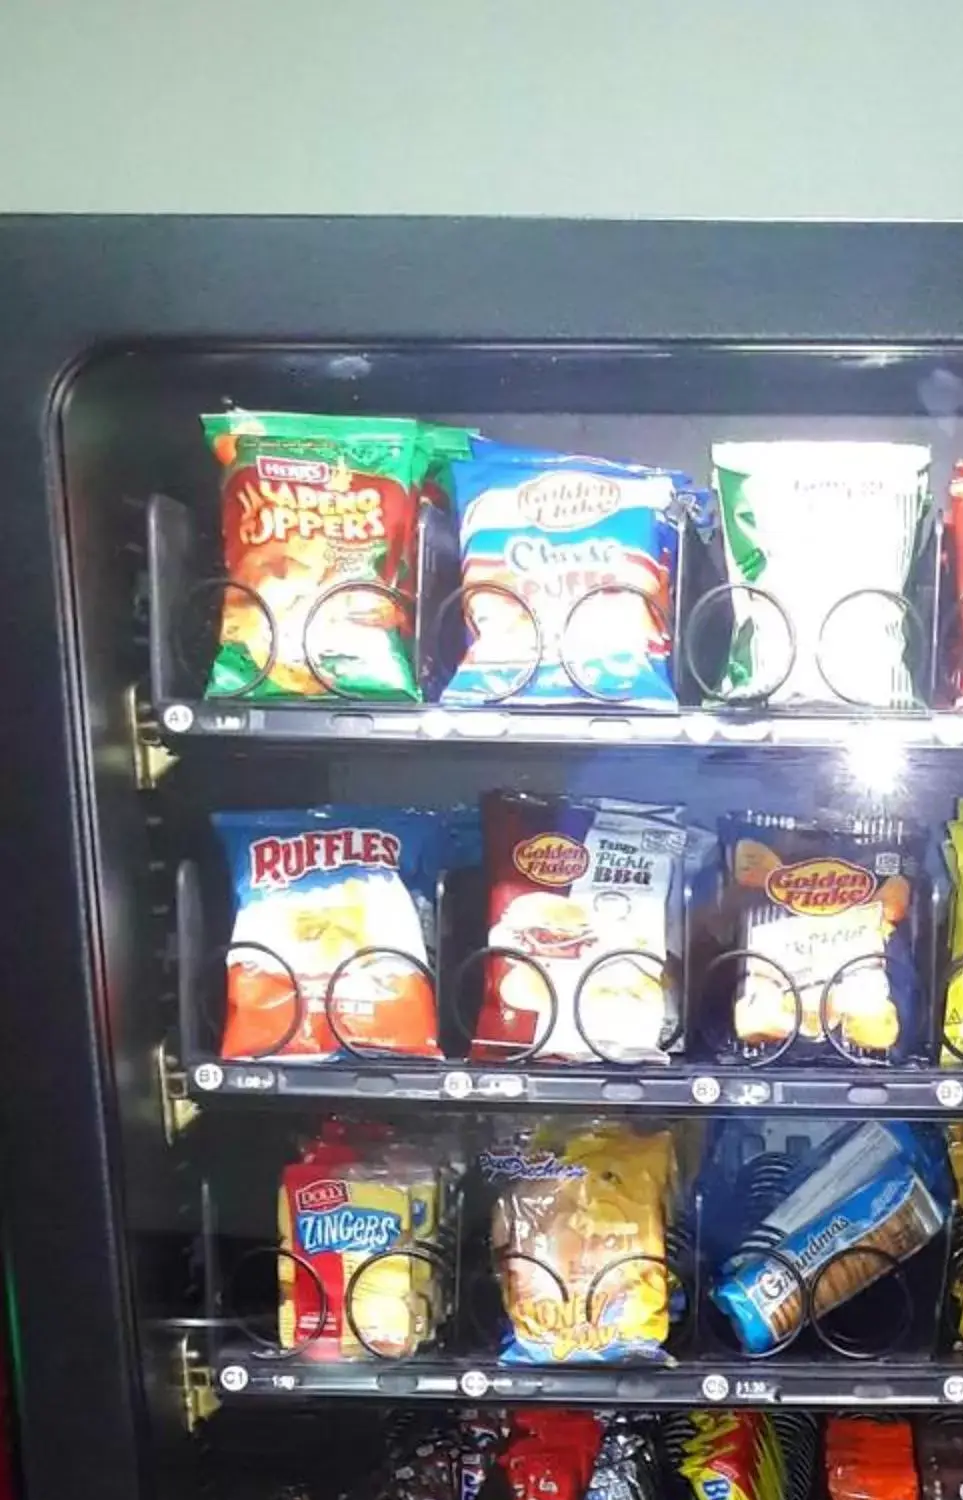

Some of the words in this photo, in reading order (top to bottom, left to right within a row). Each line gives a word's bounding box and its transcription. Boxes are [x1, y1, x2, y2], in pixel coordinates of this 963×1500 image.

[252, 829, 400, 886] RUFFLES
[597, 851, 655, 869] Pickle
[592, 866, 653, 885] BBQ
[778, 870, 868, 890] Golden
[785, 888, 864, 907] Flake
[223, 1367, 245, 1385] C1
